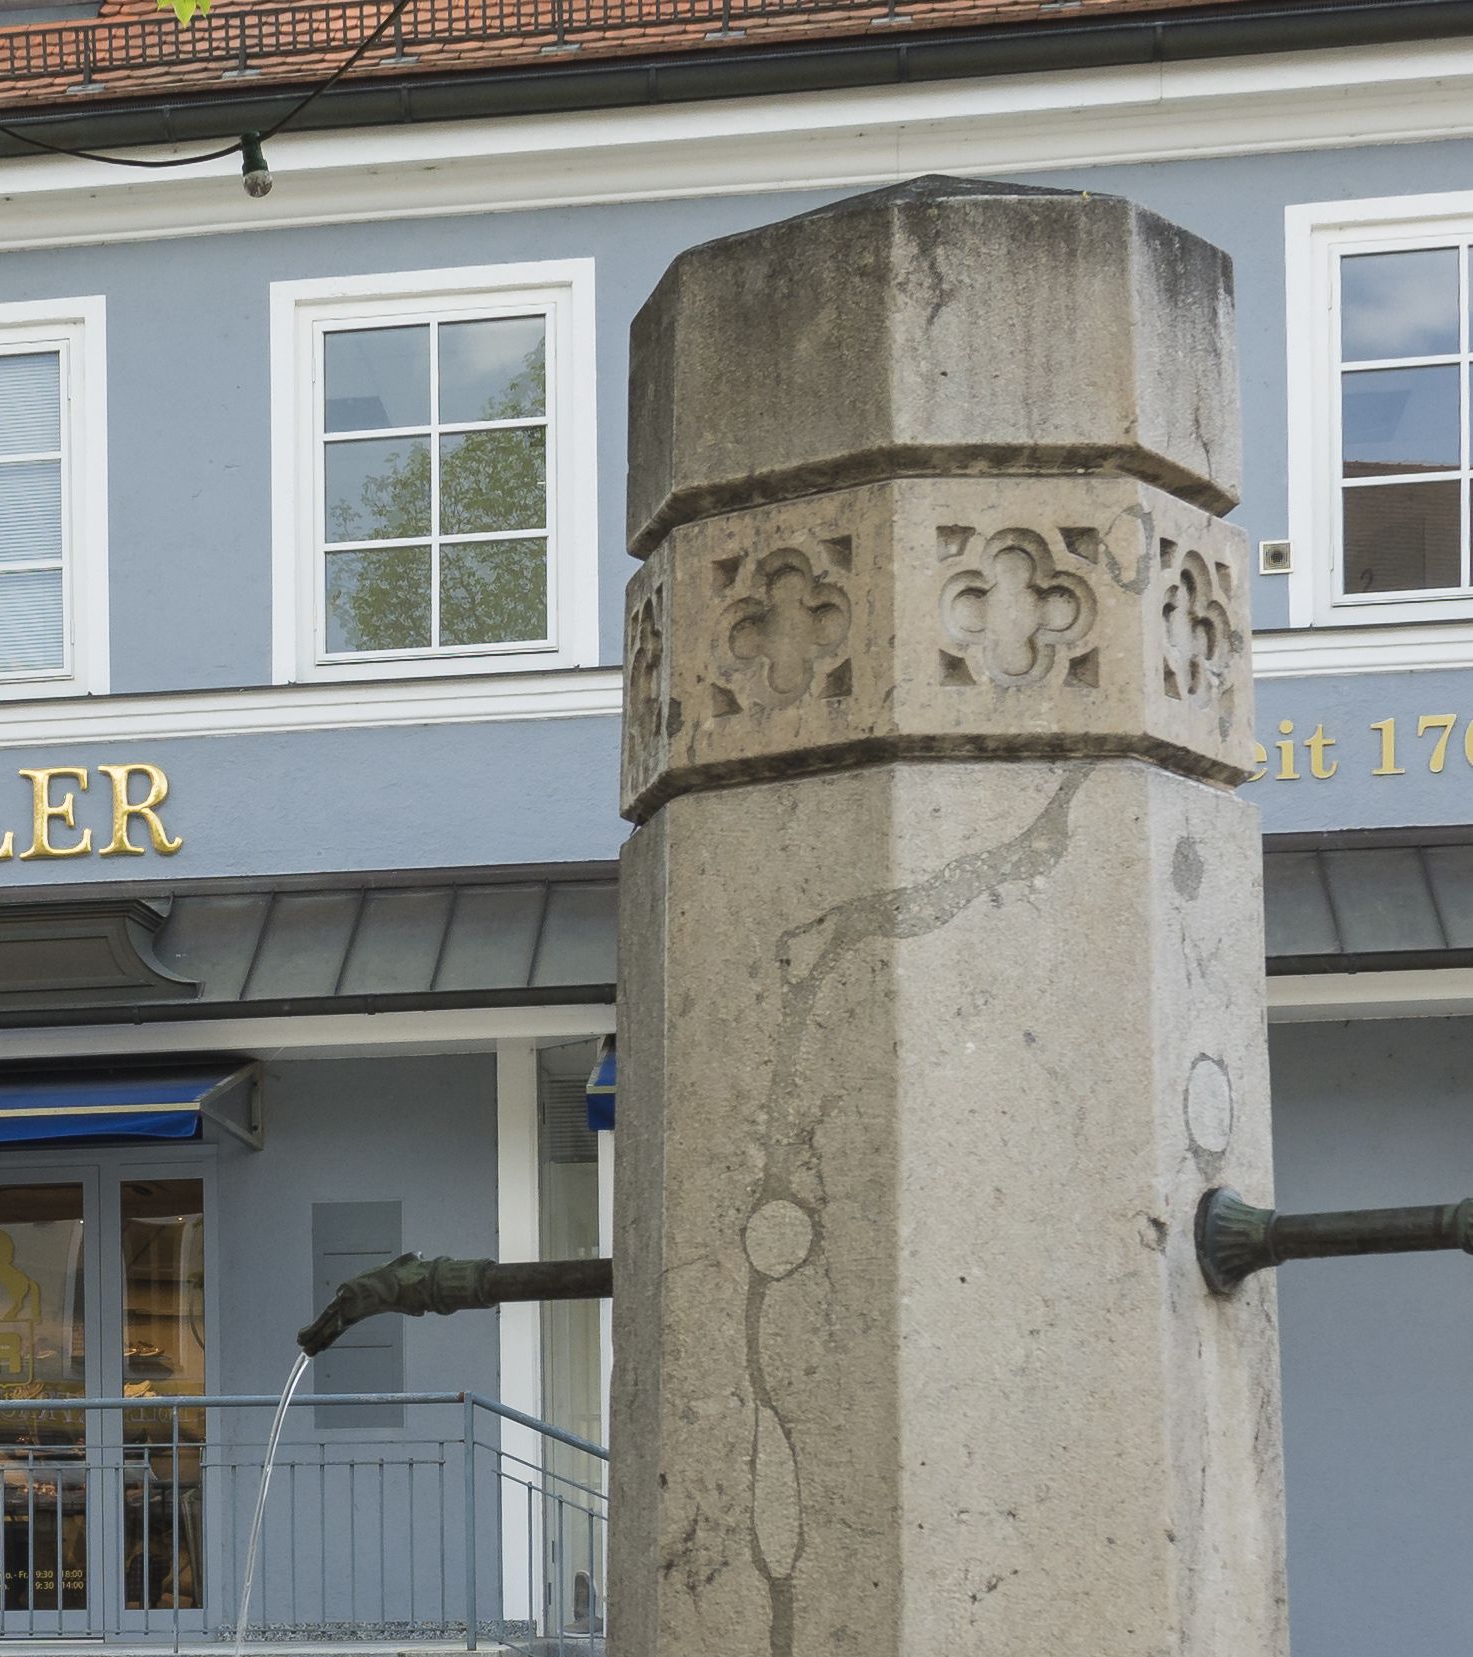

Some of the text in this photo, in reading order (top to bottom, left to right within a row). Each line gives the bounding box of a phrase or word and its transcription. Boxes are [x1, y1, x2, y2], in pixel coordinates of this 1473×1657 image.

[1247, 719, 1338, 781] eit
[35, 1570, 54, 1579] 9:30
[35, 1581, 55, 1590] 9:30
